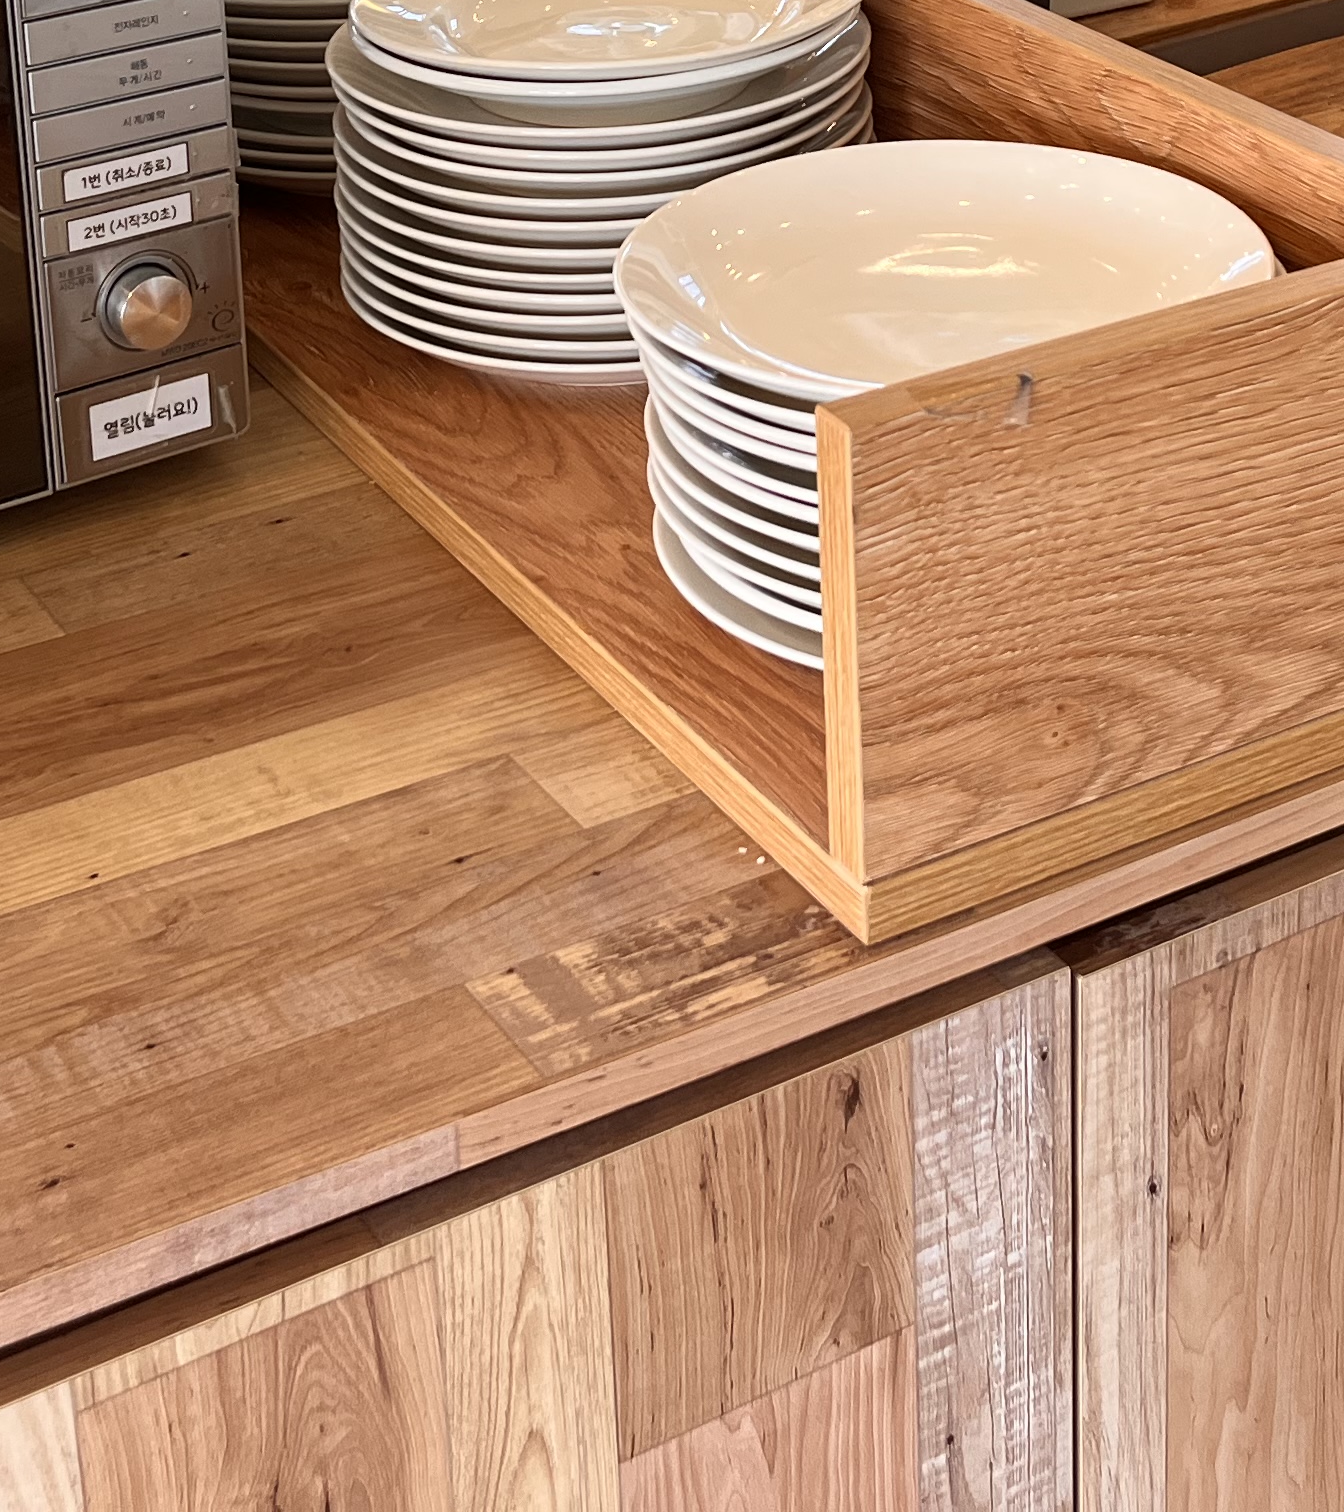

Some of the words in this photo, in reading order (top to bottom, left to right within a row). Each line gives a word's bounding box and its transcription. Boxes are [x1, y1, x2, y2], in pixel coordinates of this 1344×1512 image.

[114, 14, 159, 33] 전자레인지
[81, 171, 102, 189] 1번
[105, 156, 172, 185] (취소/종료)
[84, 222, 106, 240] 2번
[109, 205, 178, 236] (시작30초)
